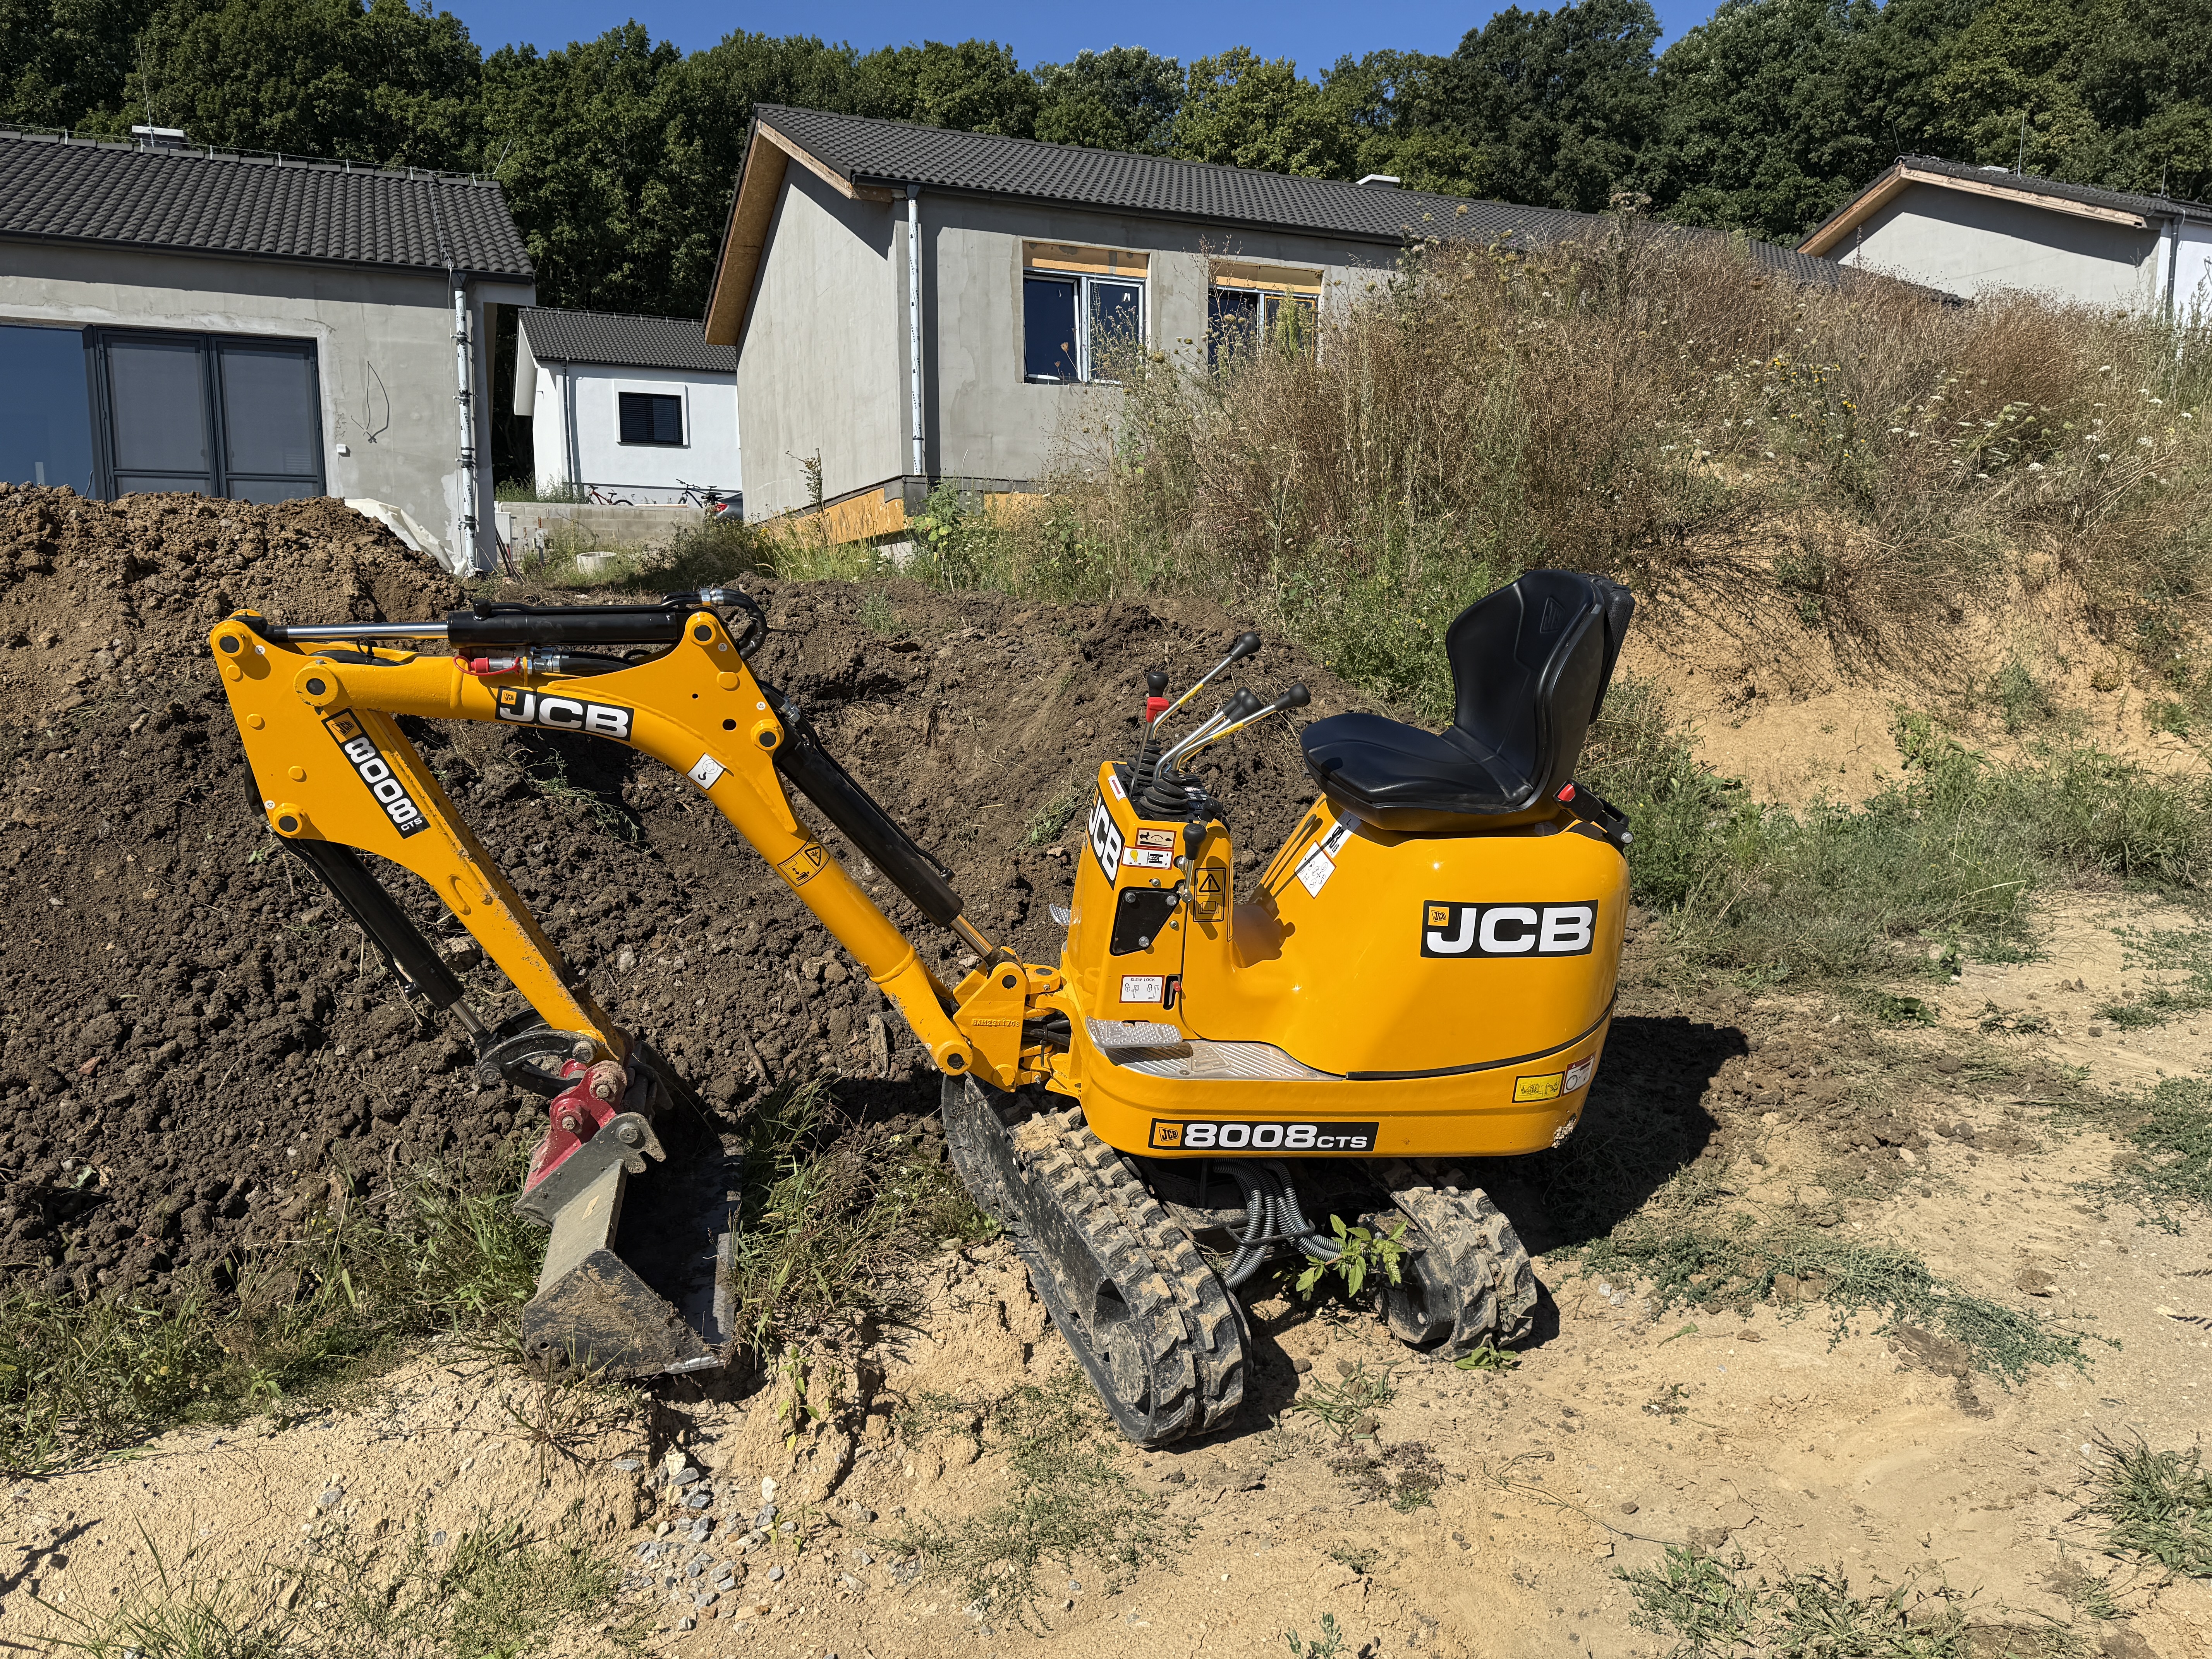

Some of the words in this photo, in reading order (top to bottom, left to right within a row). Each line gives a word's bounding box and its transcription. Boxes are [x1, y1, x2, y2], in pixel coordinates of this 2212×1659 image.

[335, 721, 353, 734] JCB
[500, 693, 629, 738] JCB
[344, 737, 417, 824] 8008
[400, 817, 422, 831] CTS
[1089, 795, 1122, 881] JCB
[1427, 906, 1592, 953] JCB
[1434, 911, 1445, 921] JCB
[1162, 1129, 1178, 1140] JCB
